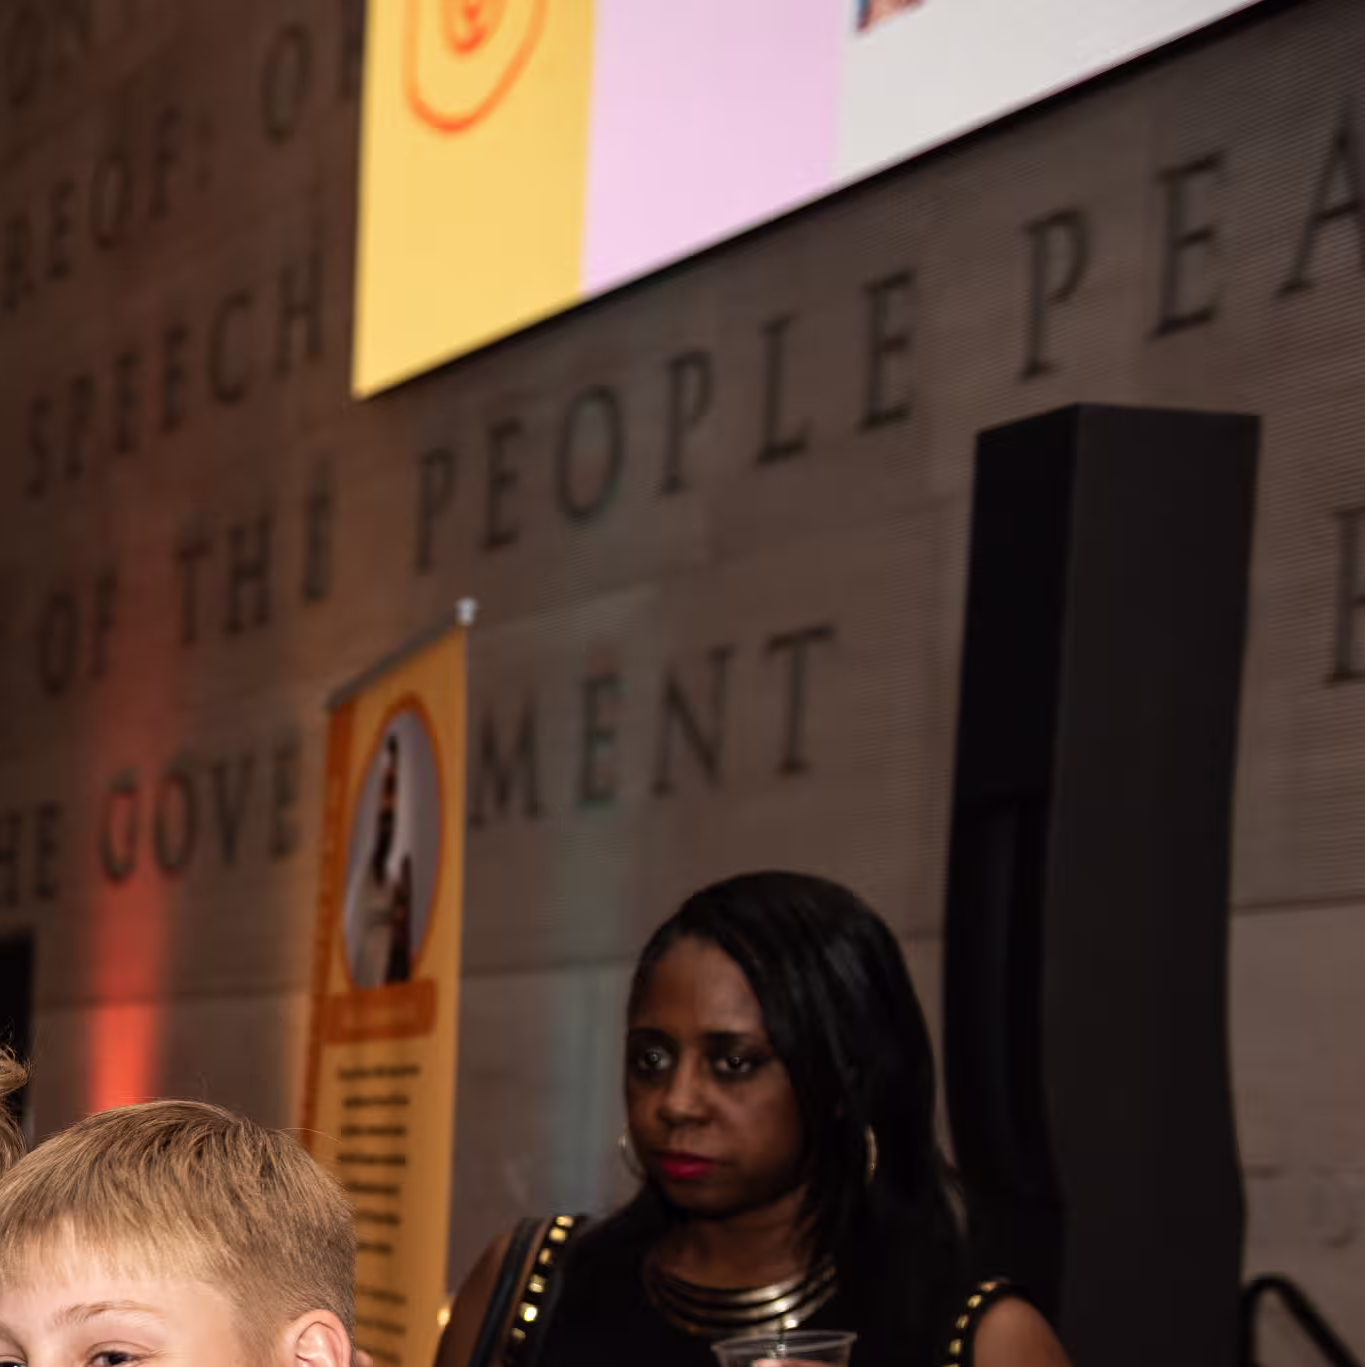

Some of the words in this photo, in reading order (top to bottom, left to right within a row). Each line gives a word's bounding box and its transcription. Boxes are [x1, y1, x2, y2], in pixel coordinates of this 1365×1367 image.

[21, 218, 325, 500] SPEECH
[413, 264, 921, 576] PEOPLE
[97, 616, 847, 886] GOVEMENT
